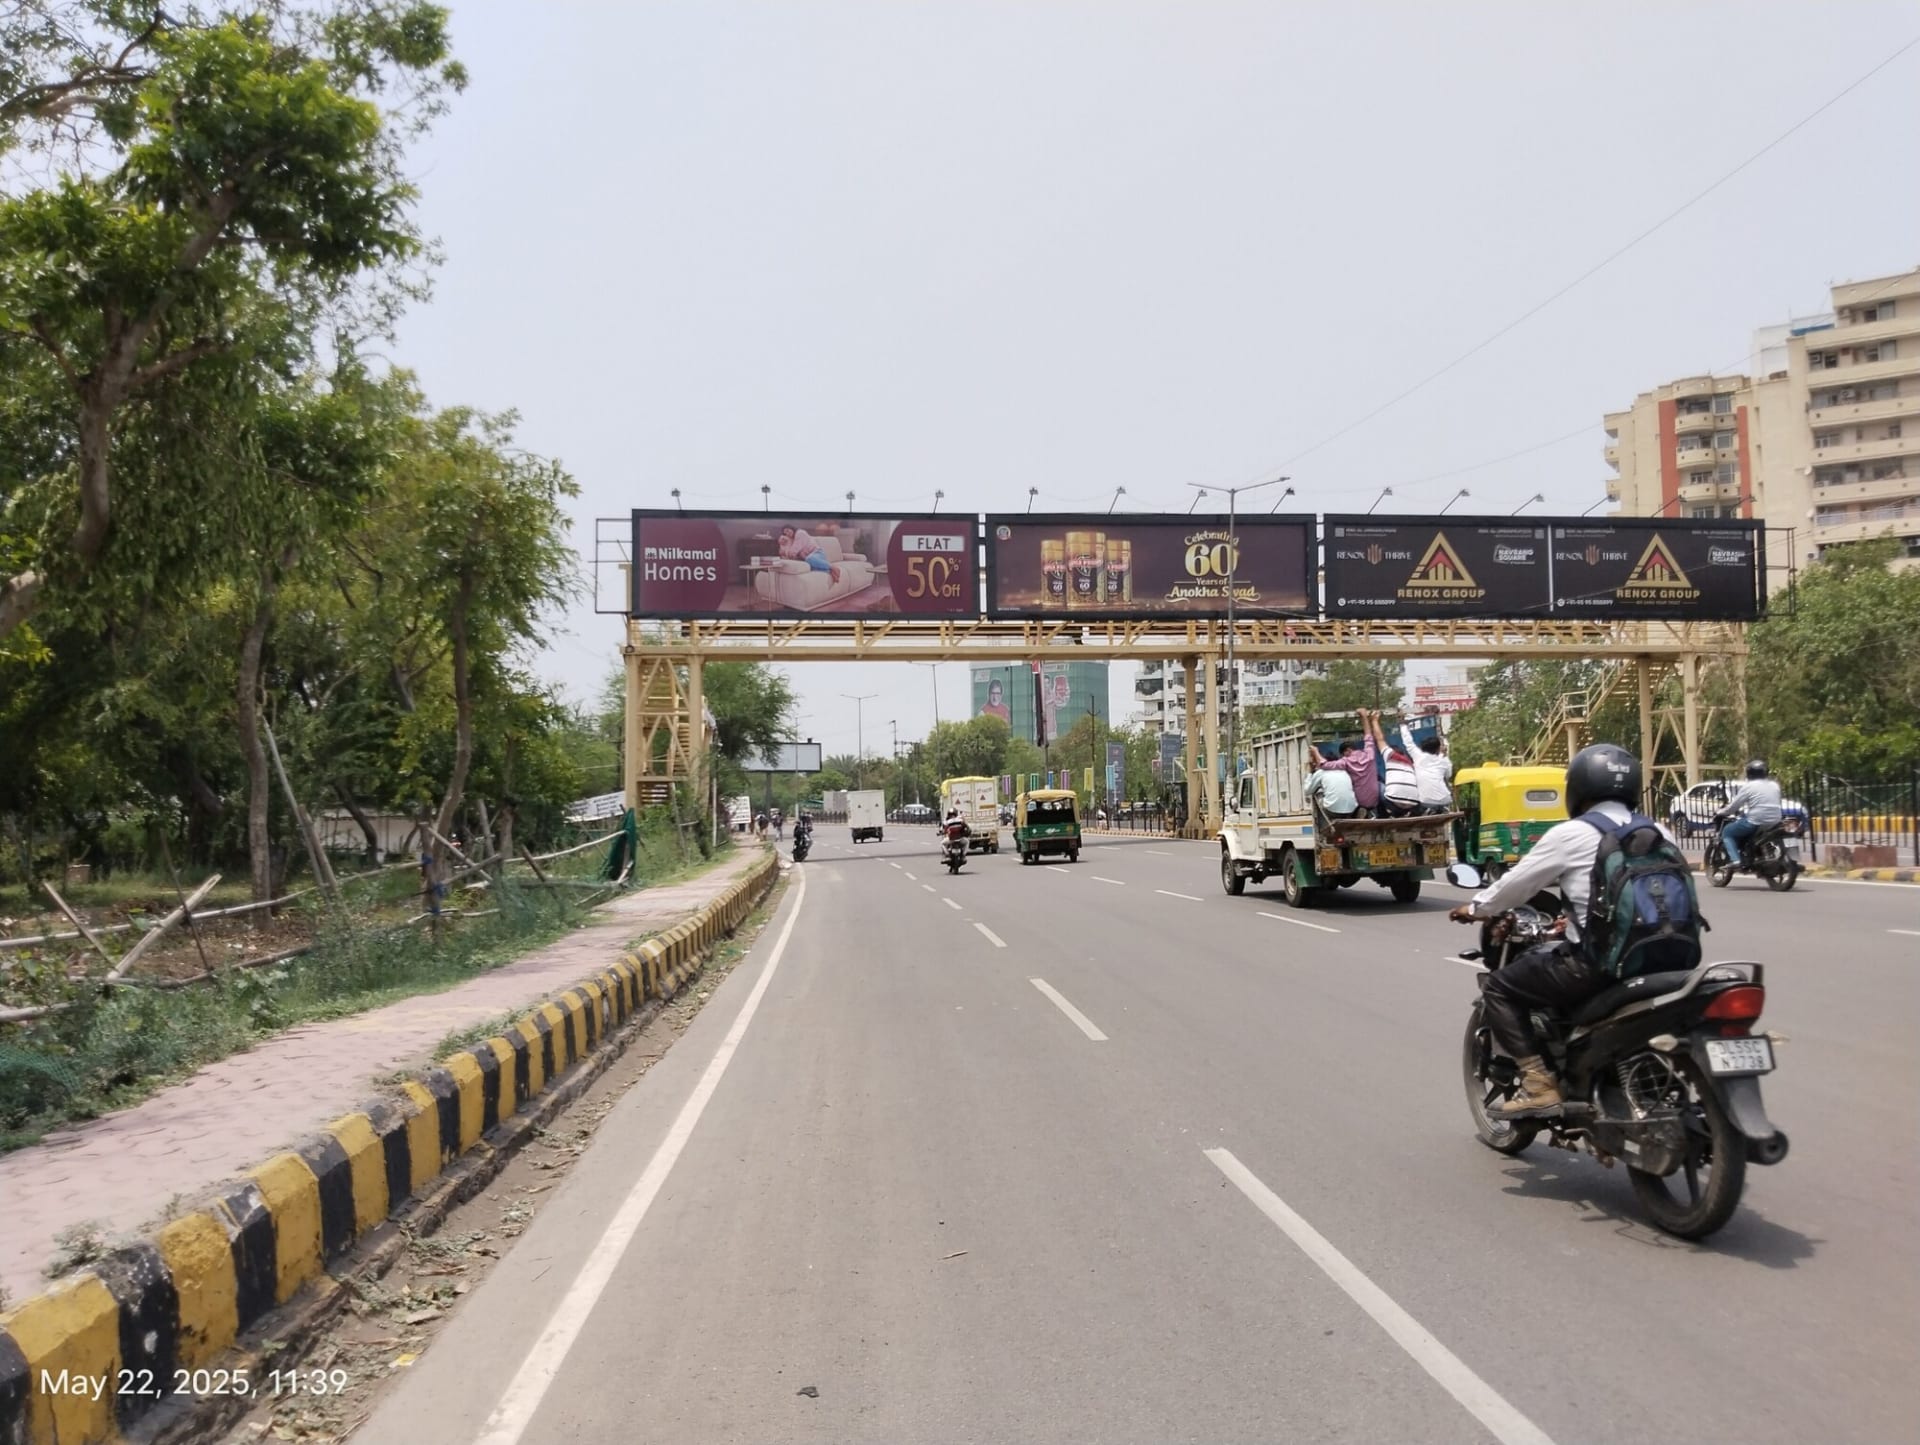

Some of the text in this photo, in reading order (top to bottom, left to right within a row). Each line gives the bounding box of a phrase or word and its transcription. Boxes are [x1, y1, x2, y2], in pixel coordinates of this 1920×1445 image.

[918, 538, 951, 550] FLAT
[658, 547, 717, 561] Nilkamal
[1184, 543, 1239, 576] 60
[644, 562, 717, 582] Homes
[1196, 577, 1228, 585] Years of
[942, 579, 960, 597] Off
[1171, 586, 1219, 597] Anokha
[1397, 589, 1486, 598] RENOX GROUP
[1616, 589, 1701, 598] RENOX GROUP
